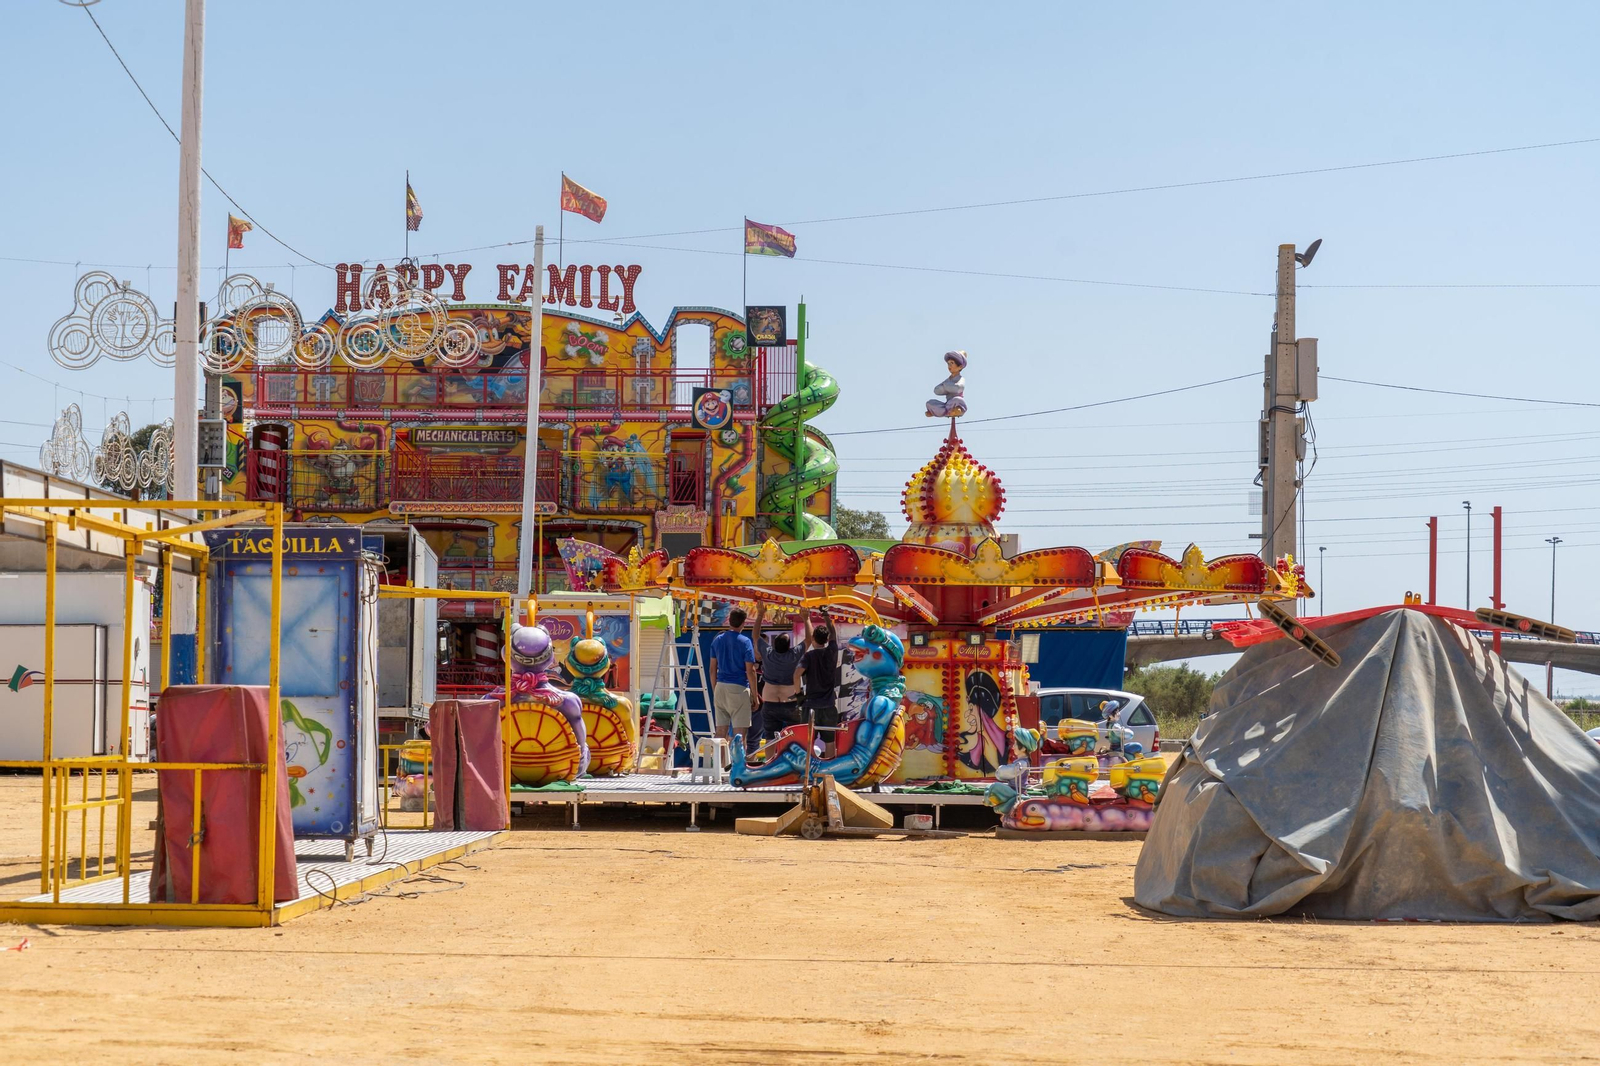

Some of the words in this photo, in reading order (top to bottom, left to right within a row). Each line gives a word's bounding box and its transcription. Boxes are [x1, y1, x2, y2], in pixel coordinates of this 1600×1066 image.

[335, 263, 472, 313] HAPPY
[496, 264, 642, 314] FAMILY
[358, 381, 380, 400] DK
[481, 430, 514, 442] PARTS
[223, 468, 233, 479] 20
